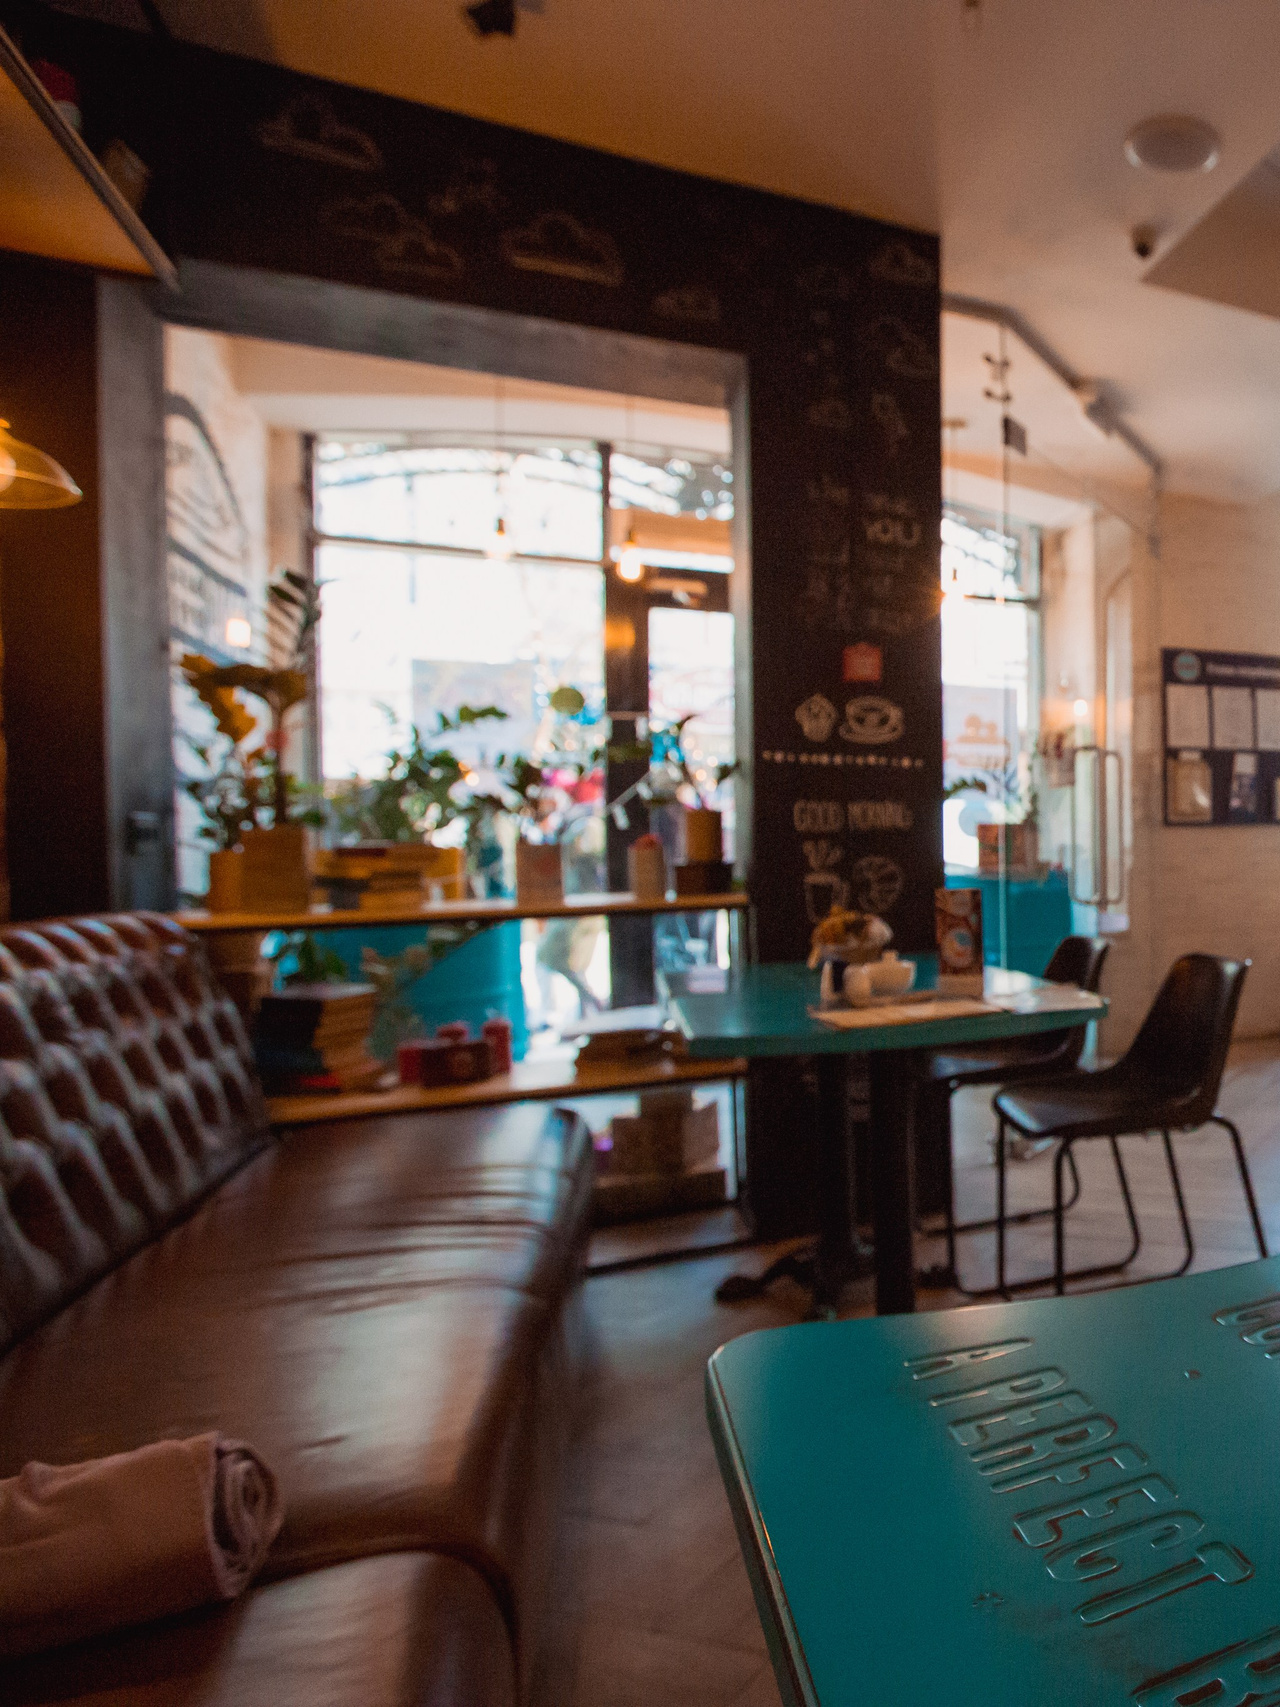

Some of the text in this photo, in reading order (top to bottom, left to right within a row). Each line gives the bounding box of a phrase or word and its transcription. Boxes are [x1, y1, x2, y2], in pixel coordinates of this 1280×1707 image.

[793, 799, 842, 833] GOOD
[904, 1337, 1034, 1380] A
[928, 1366, 1255, 1627] PERFECT
